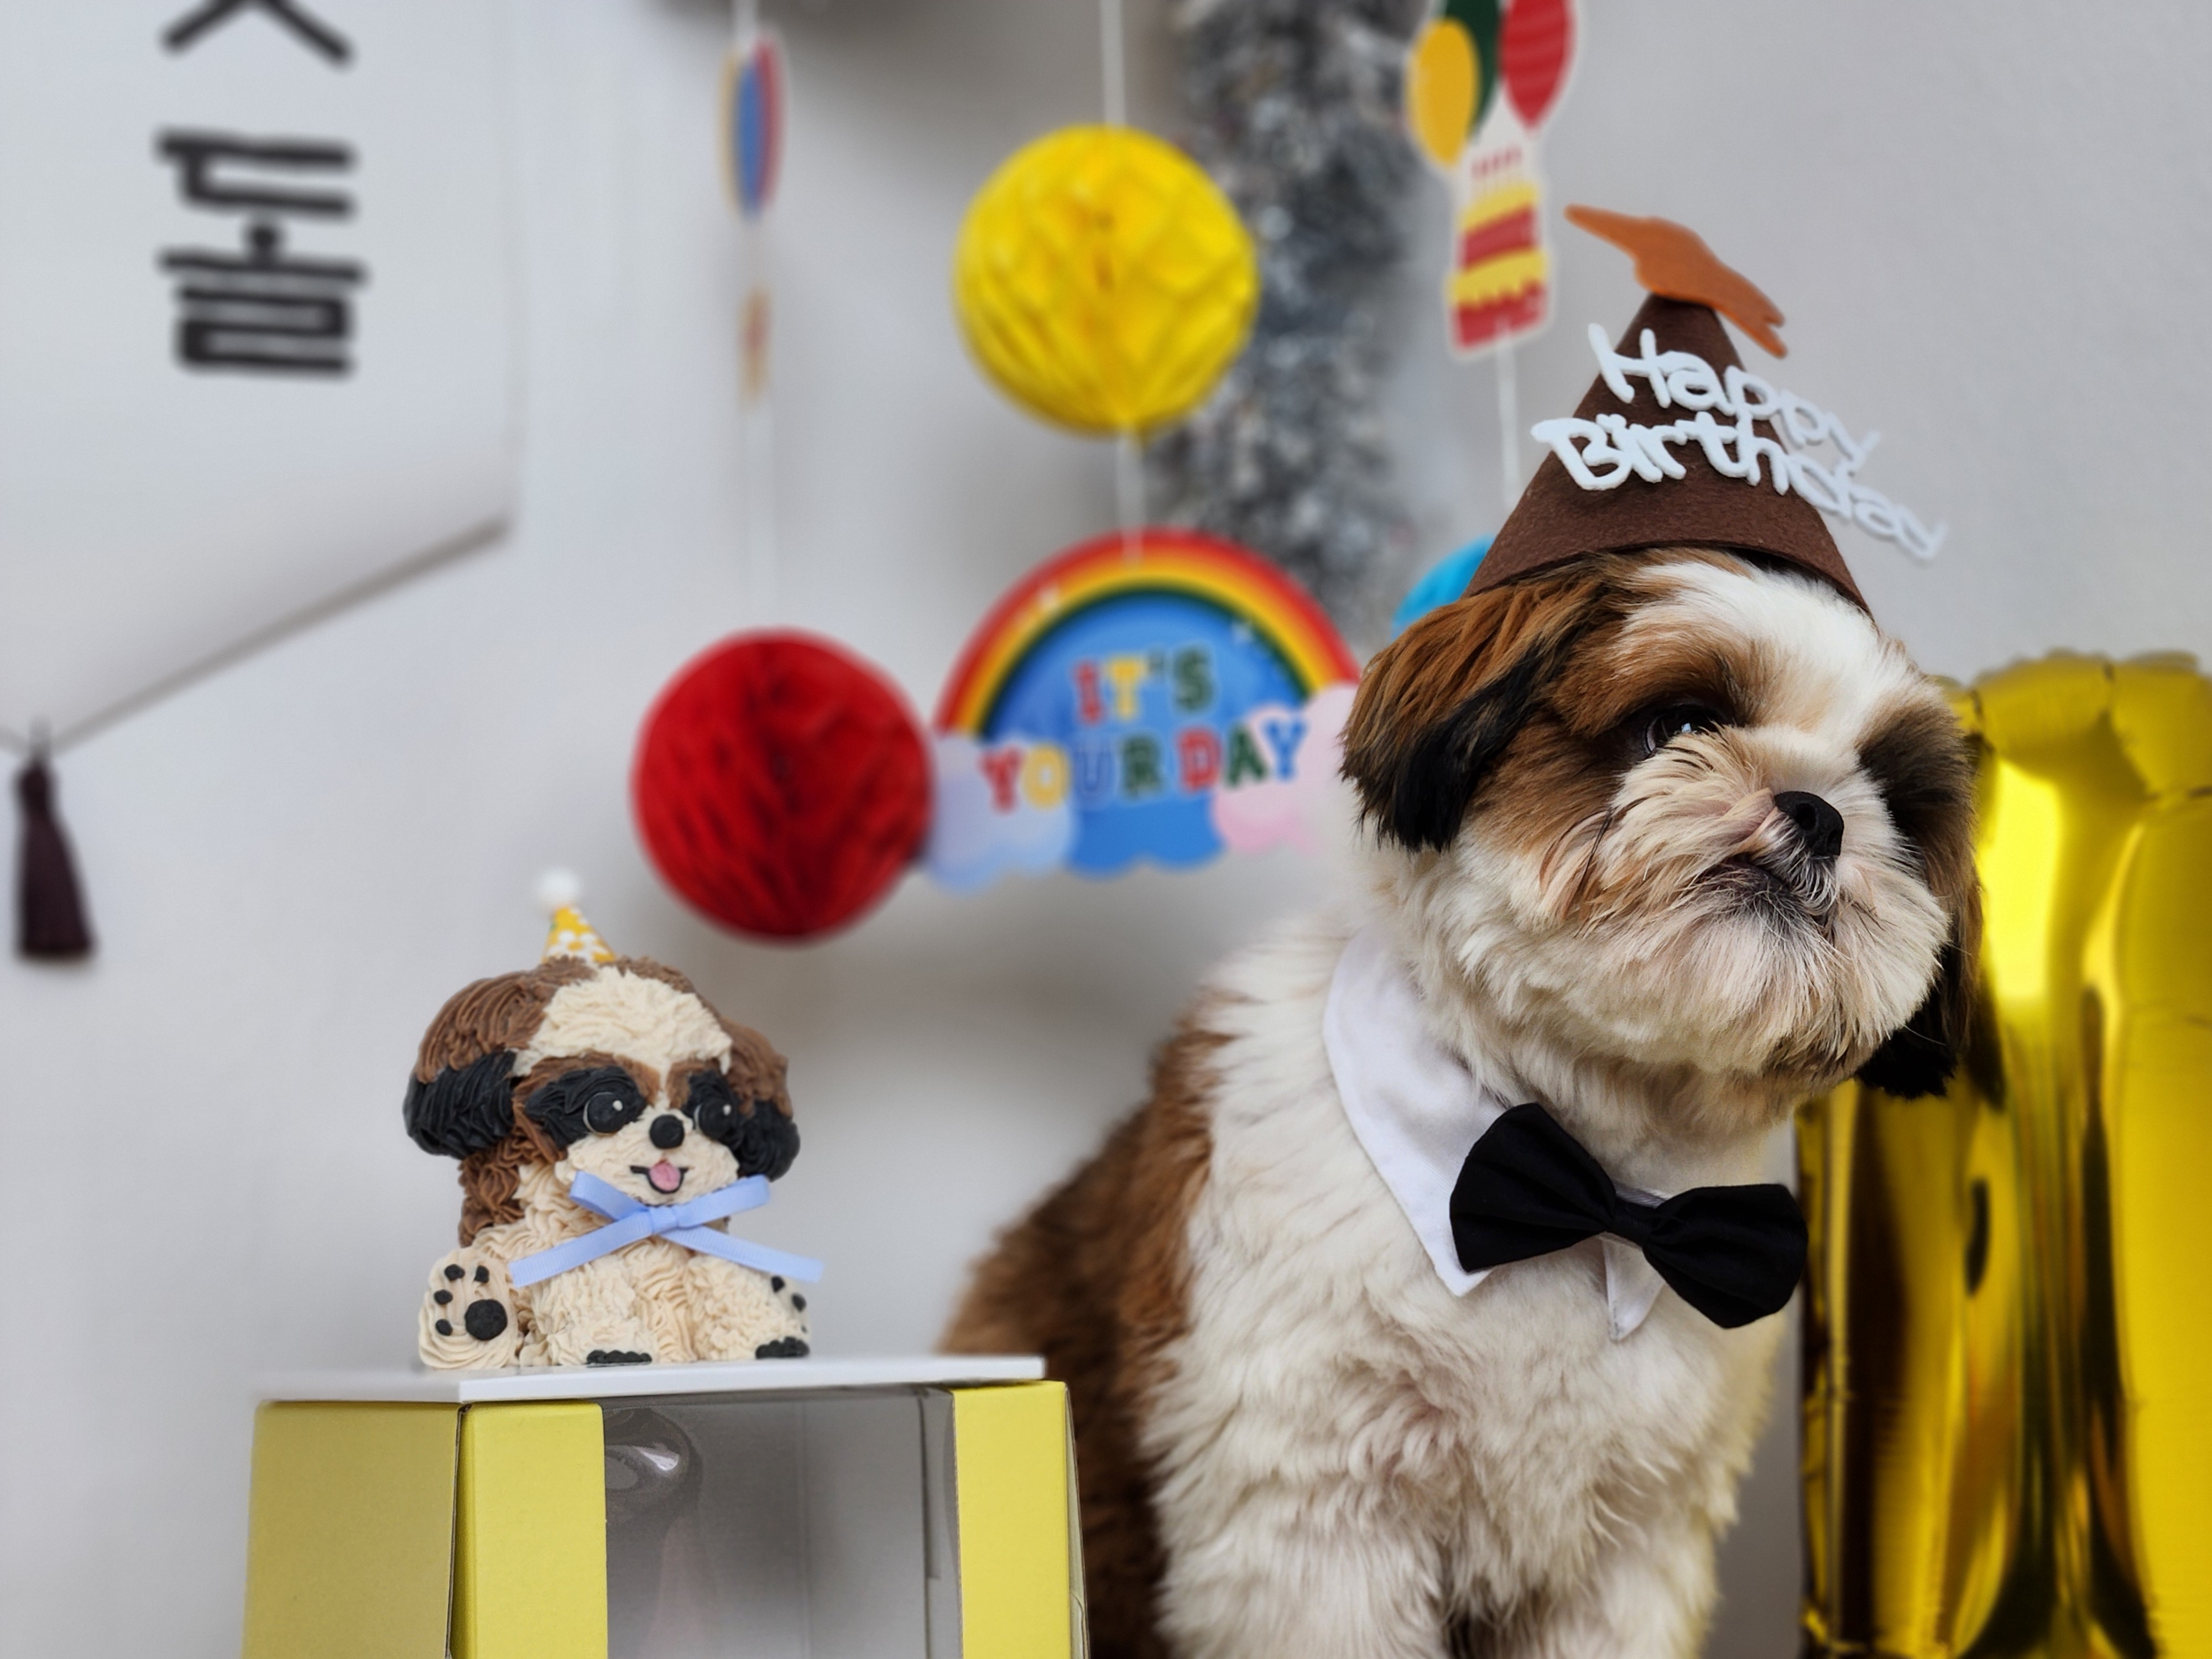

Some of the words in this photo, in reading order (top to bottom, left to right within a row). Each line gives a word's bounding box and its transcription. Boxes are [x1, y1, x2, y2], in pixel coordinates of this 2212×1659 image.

[156, 0, 366, 378] 돌
[1588, 322, 1880, 476] Happy
[1531, 410, 1948, 561] Birthday
[1074, 648, 1212, 724] IT'S
[982, 734, 1162, 813] YOUR
[1178, 717, 1306, 794] DAY
